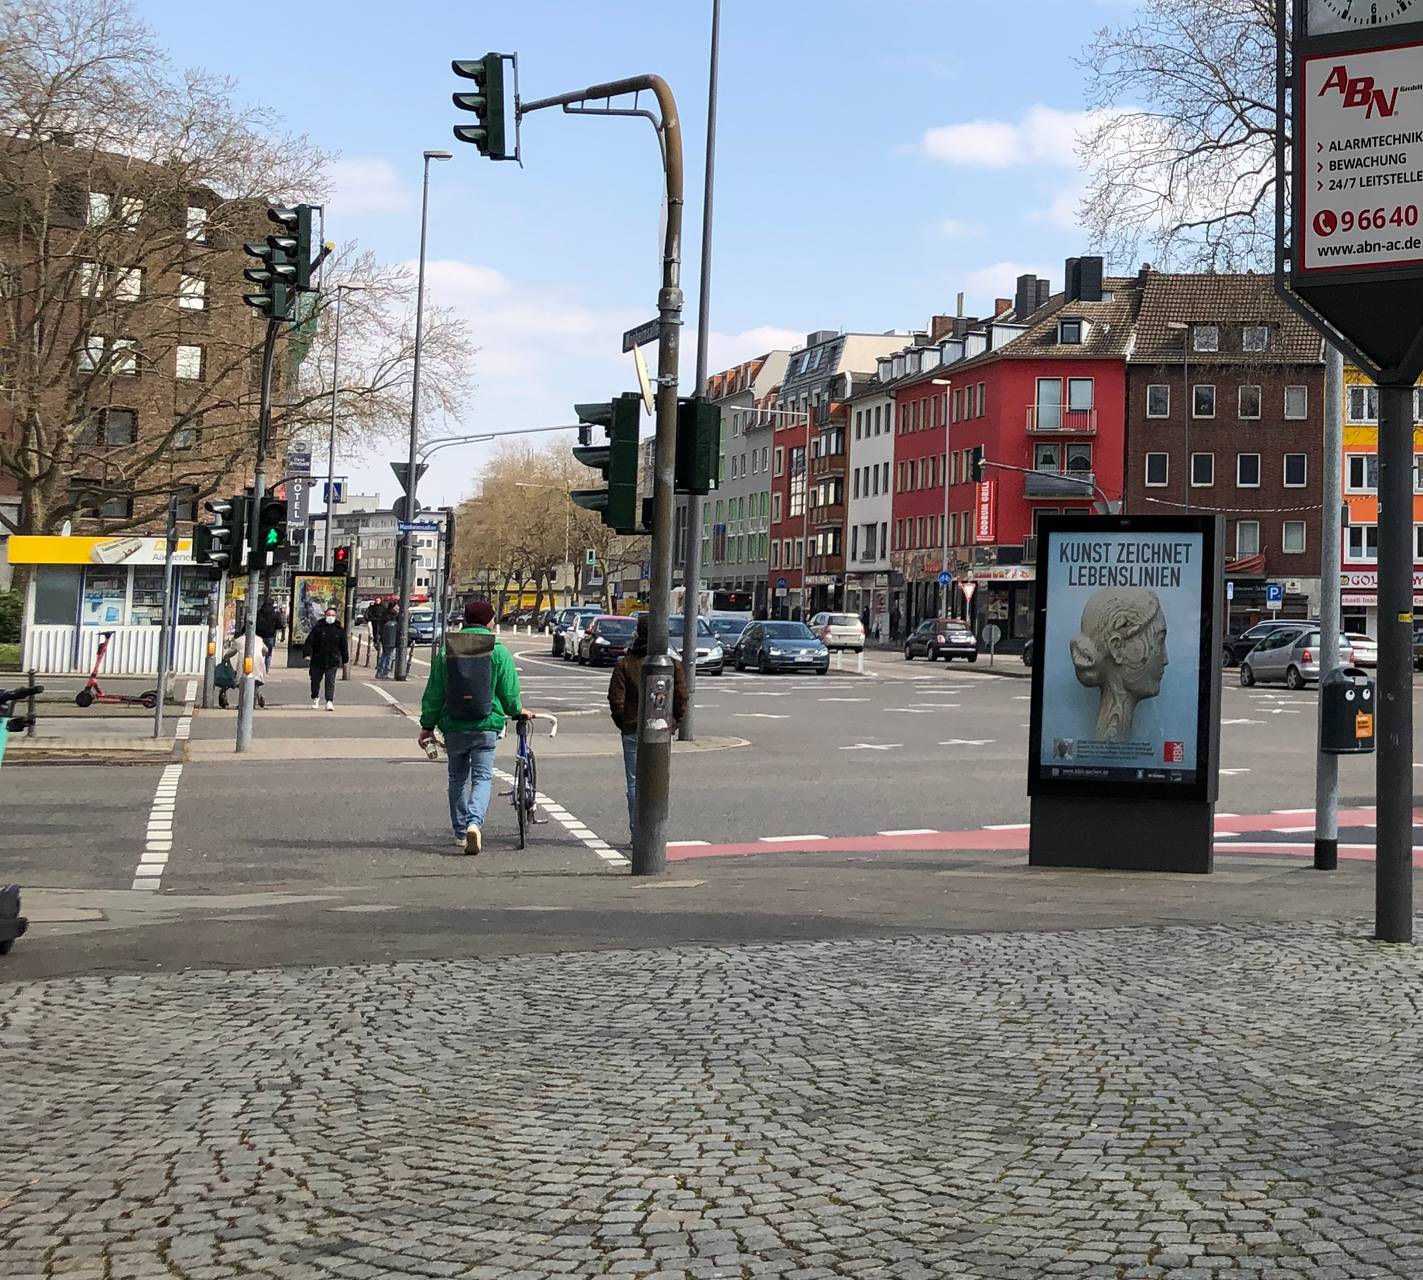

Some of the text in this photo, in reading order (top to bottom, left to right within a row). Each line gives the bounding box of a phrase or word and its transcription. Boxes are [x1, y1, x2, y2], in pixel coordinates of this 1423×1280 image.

[1371, 3, 1377, 14] 6
[1318, 65, 1399, 119] ABN
[1400, 84, 1423, 93] GmbH
[1328, 131, 1423, 153] ALARMTECHNIK
[1329, 152, 1407, 172] BEWACHUNG
[1328, 170, 1423, 191] 24/7 LEITSTELLE
[1317, 236, 1422, 257] www.abn-ac.de
[980, 480, 990, 535] BODRUM GRILL
[1060, 542, 1193, 564] KUNST ZEICHNET
[1068, 565, 1180, 587] LEBENSLINIEN
[1351, 574, 1378, 586] GOL
